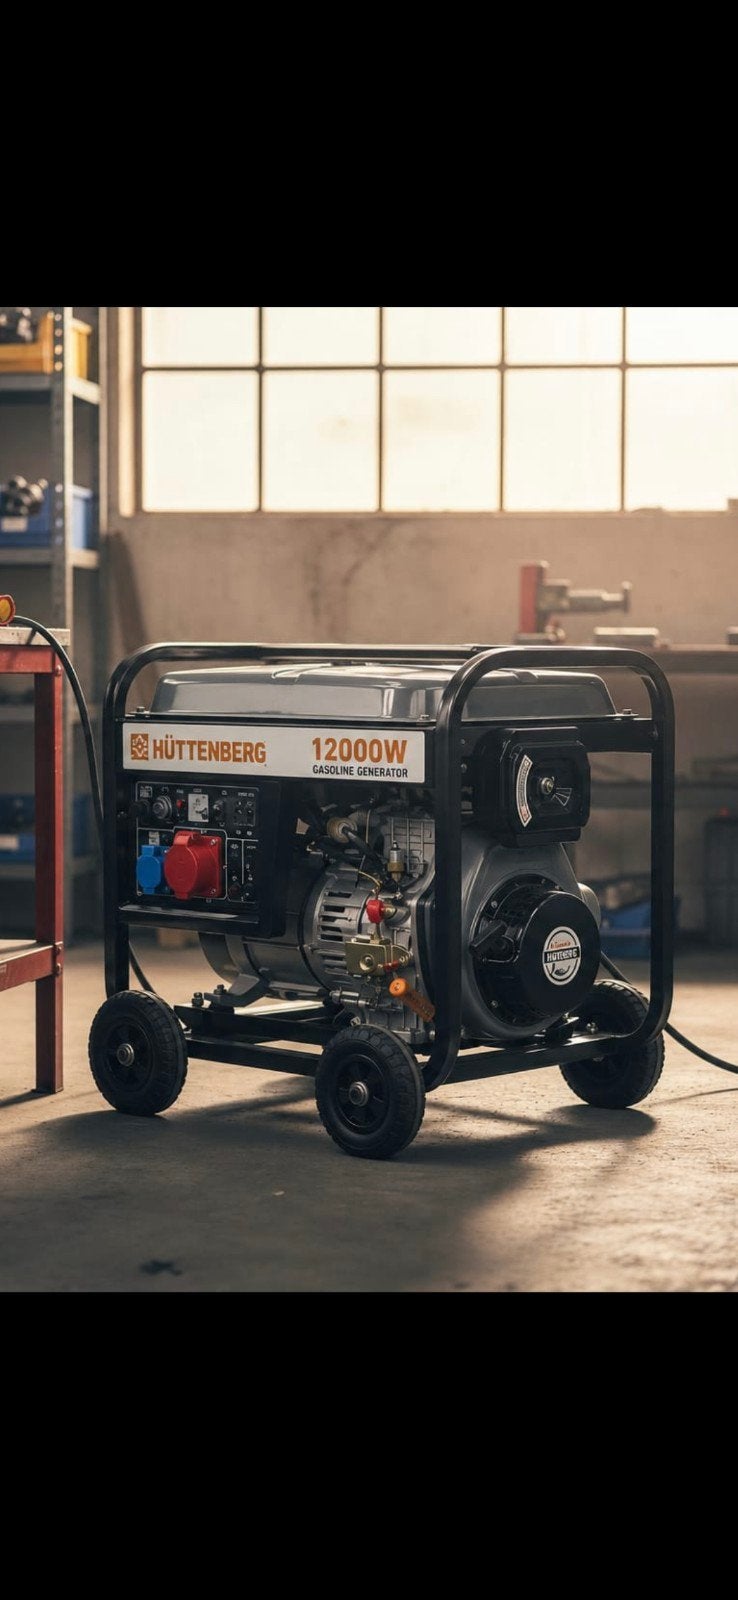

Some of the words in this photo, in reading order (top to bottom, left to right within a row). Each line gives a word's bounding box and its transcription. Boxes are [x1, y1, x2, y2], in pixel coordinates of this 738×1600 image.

[153, 734, 267, 763] HÜTTENBERG
[312, 737, 408, 764] 12000W
[312, 764, 354, 776] GASOLINE
[357, 766, 409, 778] GENERATOR
